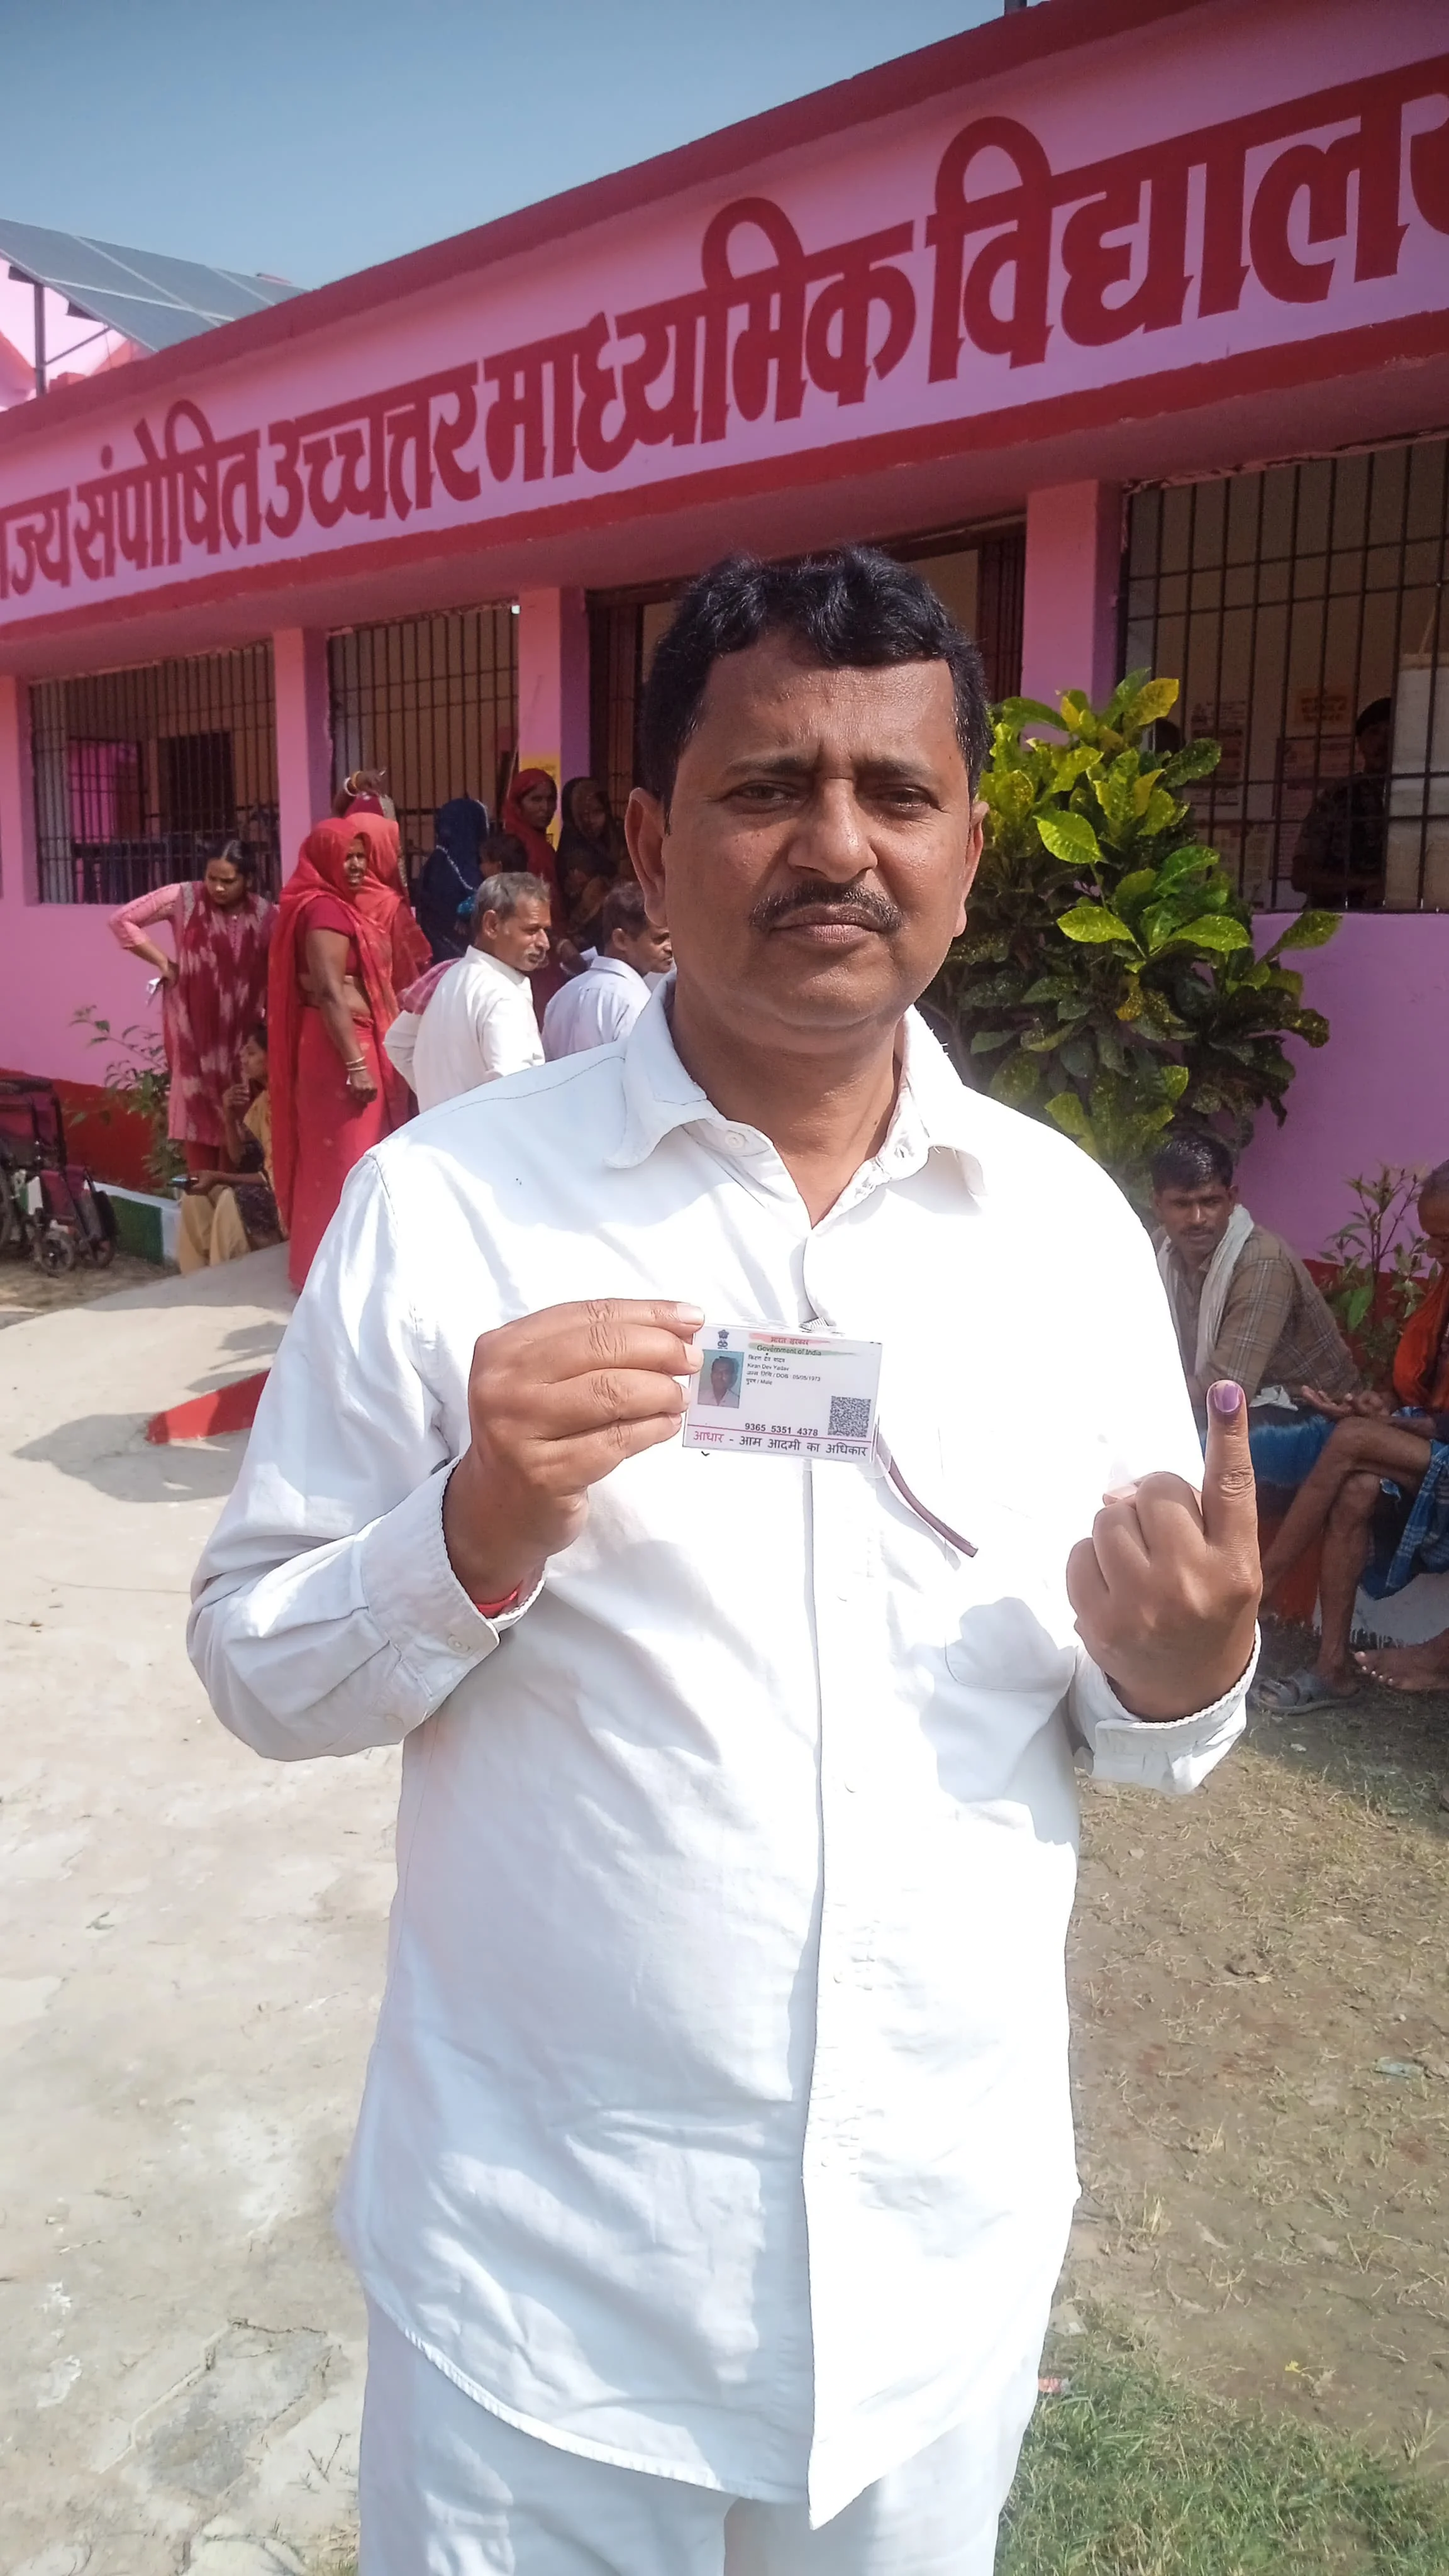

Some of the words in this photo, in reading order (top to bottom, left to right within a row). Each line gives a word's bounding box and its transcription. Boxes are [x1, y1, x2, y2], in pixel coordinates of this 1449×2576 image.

[74, 399, 260, 581] संपोषित
[484, 196, 916, 482] माध्यमिक
[757, 1345, 796, 1355] Government
[745, 1423, 766, 1432] 9365
[771, 1425, 791, 1435] 5351
[797, 1427, 818, 1436] 4378
[693, 1431, 724, 1443] आधार
[739, 1435, 762, 1447] आम
[767, 1438, 801, 1451] आदमी
[806, 1442, 820, 1453] का
[826, 1441, 868, 1457] अधिकार
